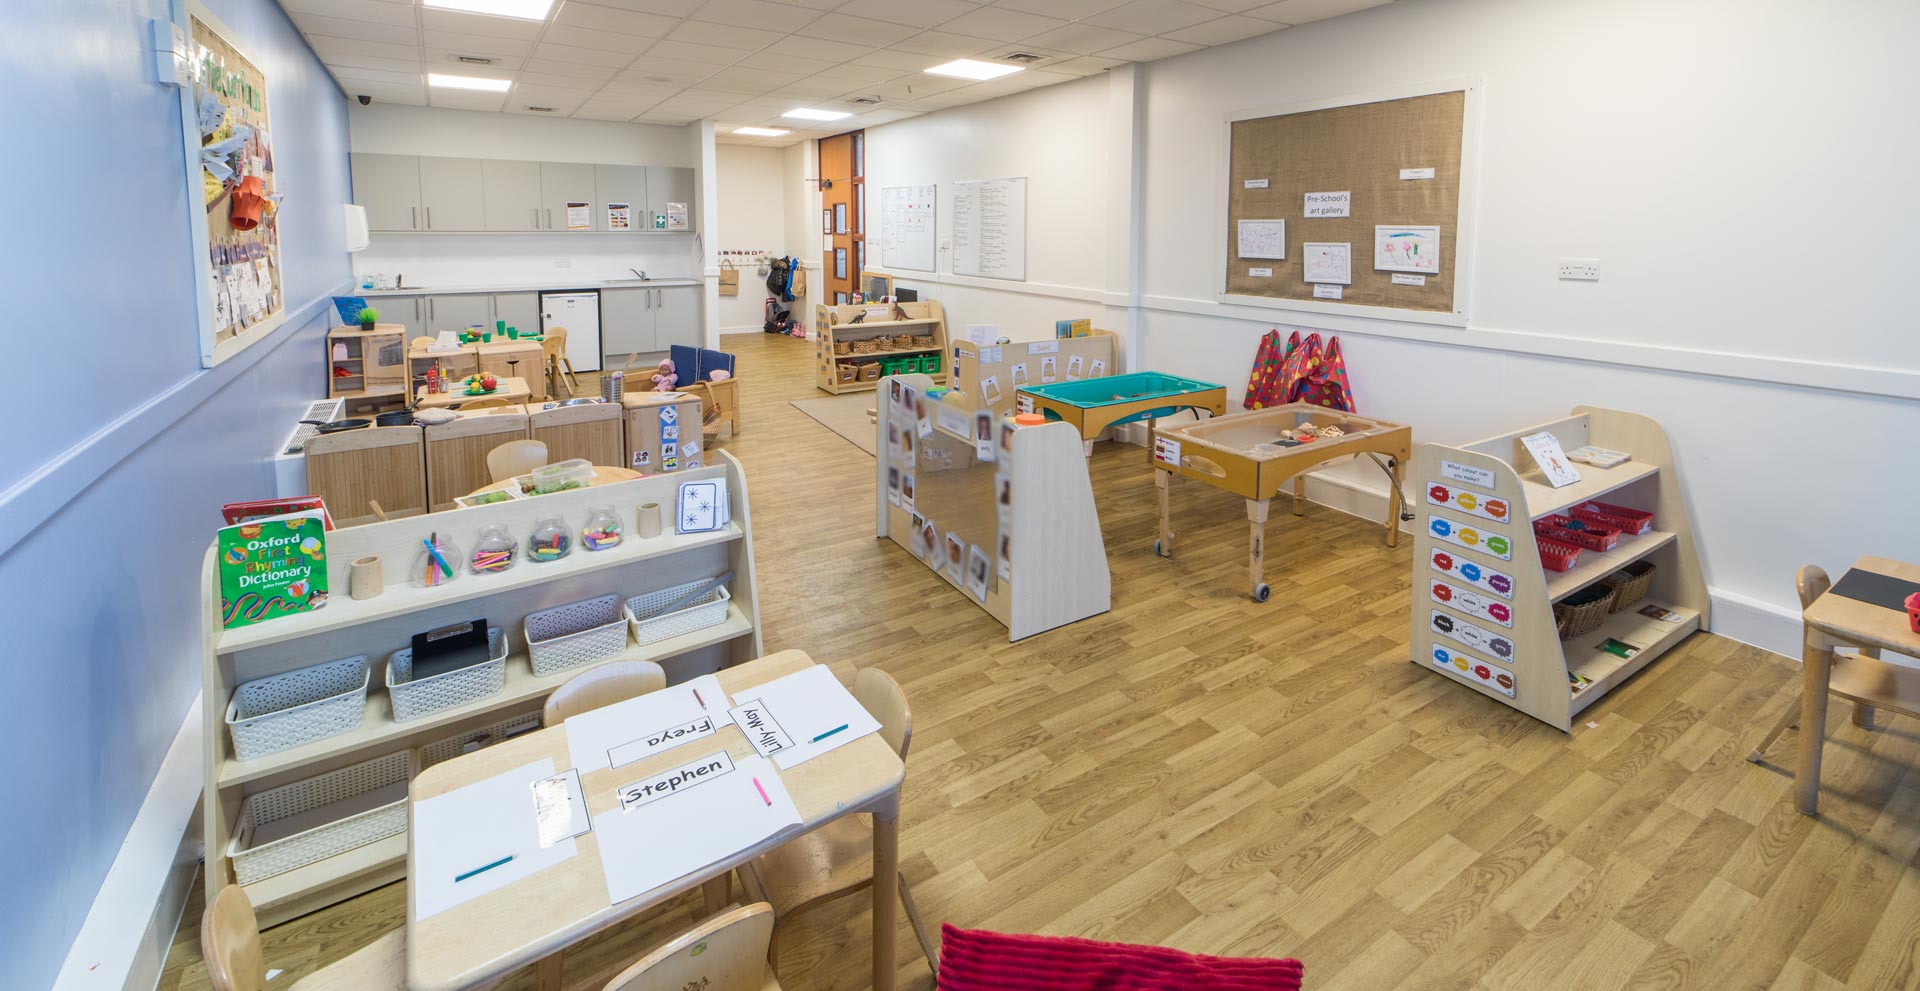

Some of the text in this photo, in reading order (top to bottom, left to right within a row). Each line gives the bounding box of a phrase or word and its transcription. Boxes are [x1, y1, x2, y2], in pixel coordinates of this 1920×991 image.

[1307, 194, 1348, 203] Pre-School's
[1321, 207, 1343, 215] gallery
[1447, 463, 1460, 471] What
[1461, 467, 1478, 475] colour
[247, 533, 300, 551] Oxford
[258, 545, 291, 560] First
[245, 556, 305, 574] Rhyming
[239, 566, 311, 588] Dictionary
[1492, 579, 1508, 587] purple
[1493, 608, 1505, 616] pink
[1437, 619, 1450, 627] black
[1465, 631, 1478, 639] white
[647, 720, 711, 747] Freya
[743, 708, 783, 754] Lilly-May
[625, 761, 723, 804] Stephen
